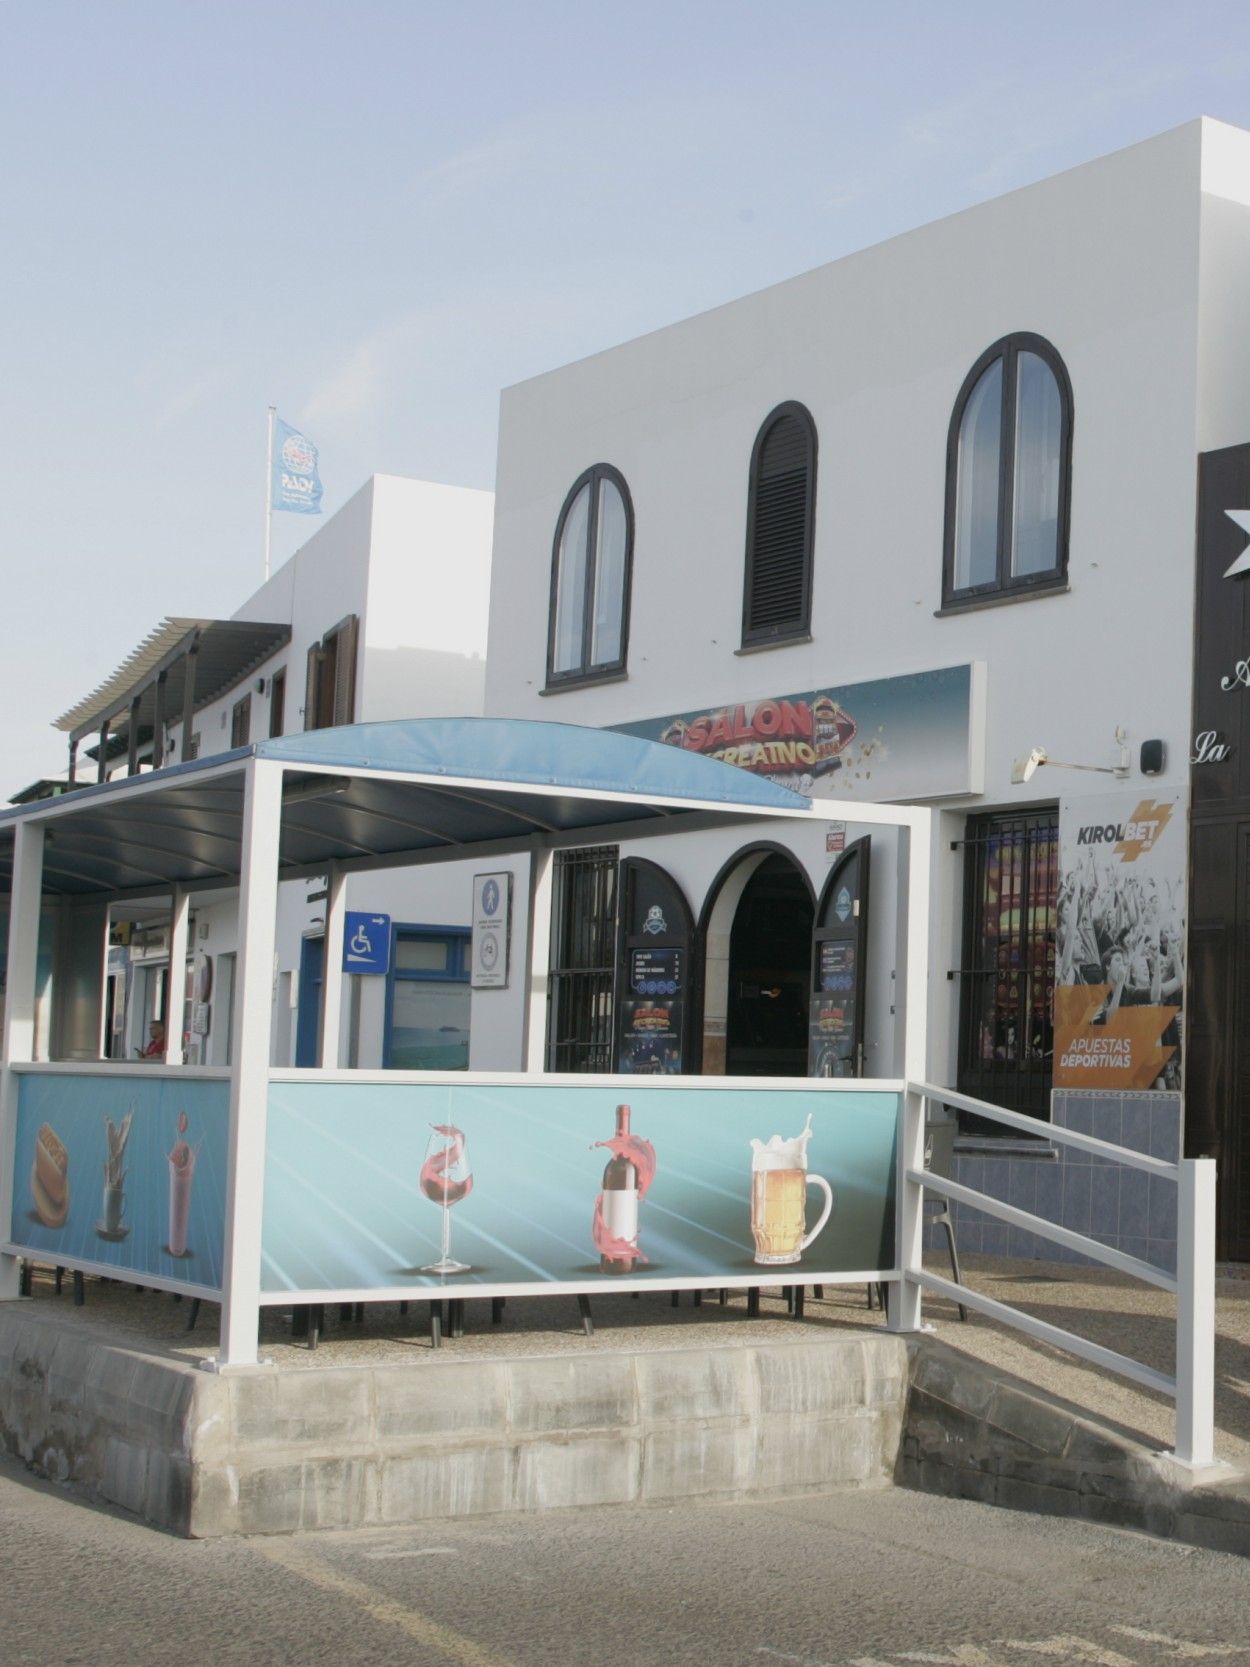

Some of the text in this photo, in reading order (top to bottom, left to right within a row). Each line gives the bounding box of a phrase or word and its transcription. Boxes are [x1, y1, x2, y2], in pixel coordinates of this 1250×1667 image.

[685, 700, 812, 753] SALON
[1190, 730, 1231, 765] La
[1077, 820, 1159, 845] KIROLBET
[1068, 1038, 1132, 1054] APUESTAS
[1060, 1053, 1132, 1069] DEPORTIVAS
